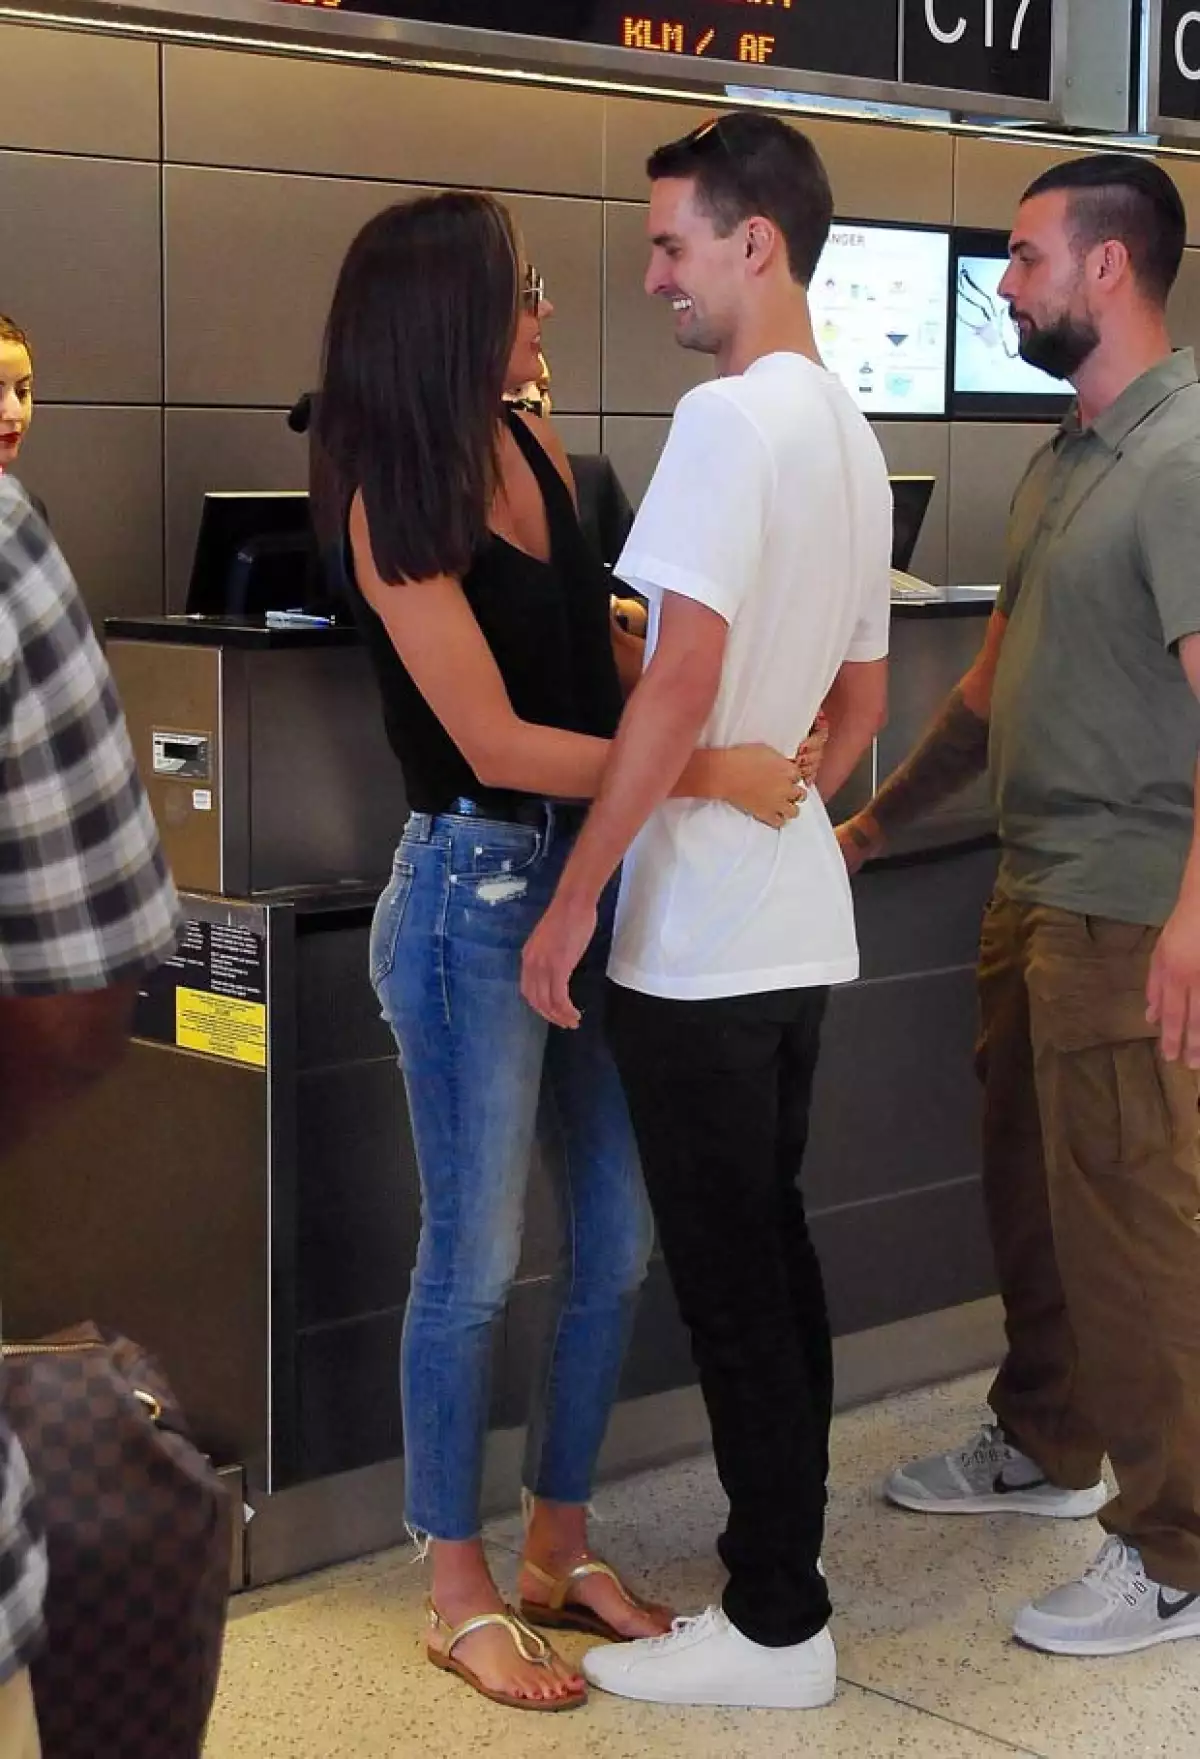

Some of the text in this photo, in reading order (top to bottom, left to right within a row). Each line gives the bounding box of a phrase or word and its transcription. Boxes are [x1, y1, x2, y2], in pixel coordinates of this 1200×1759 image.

[624, 16, 775, 63] KLM / AF
[924, 0, 1030, 50] C17
